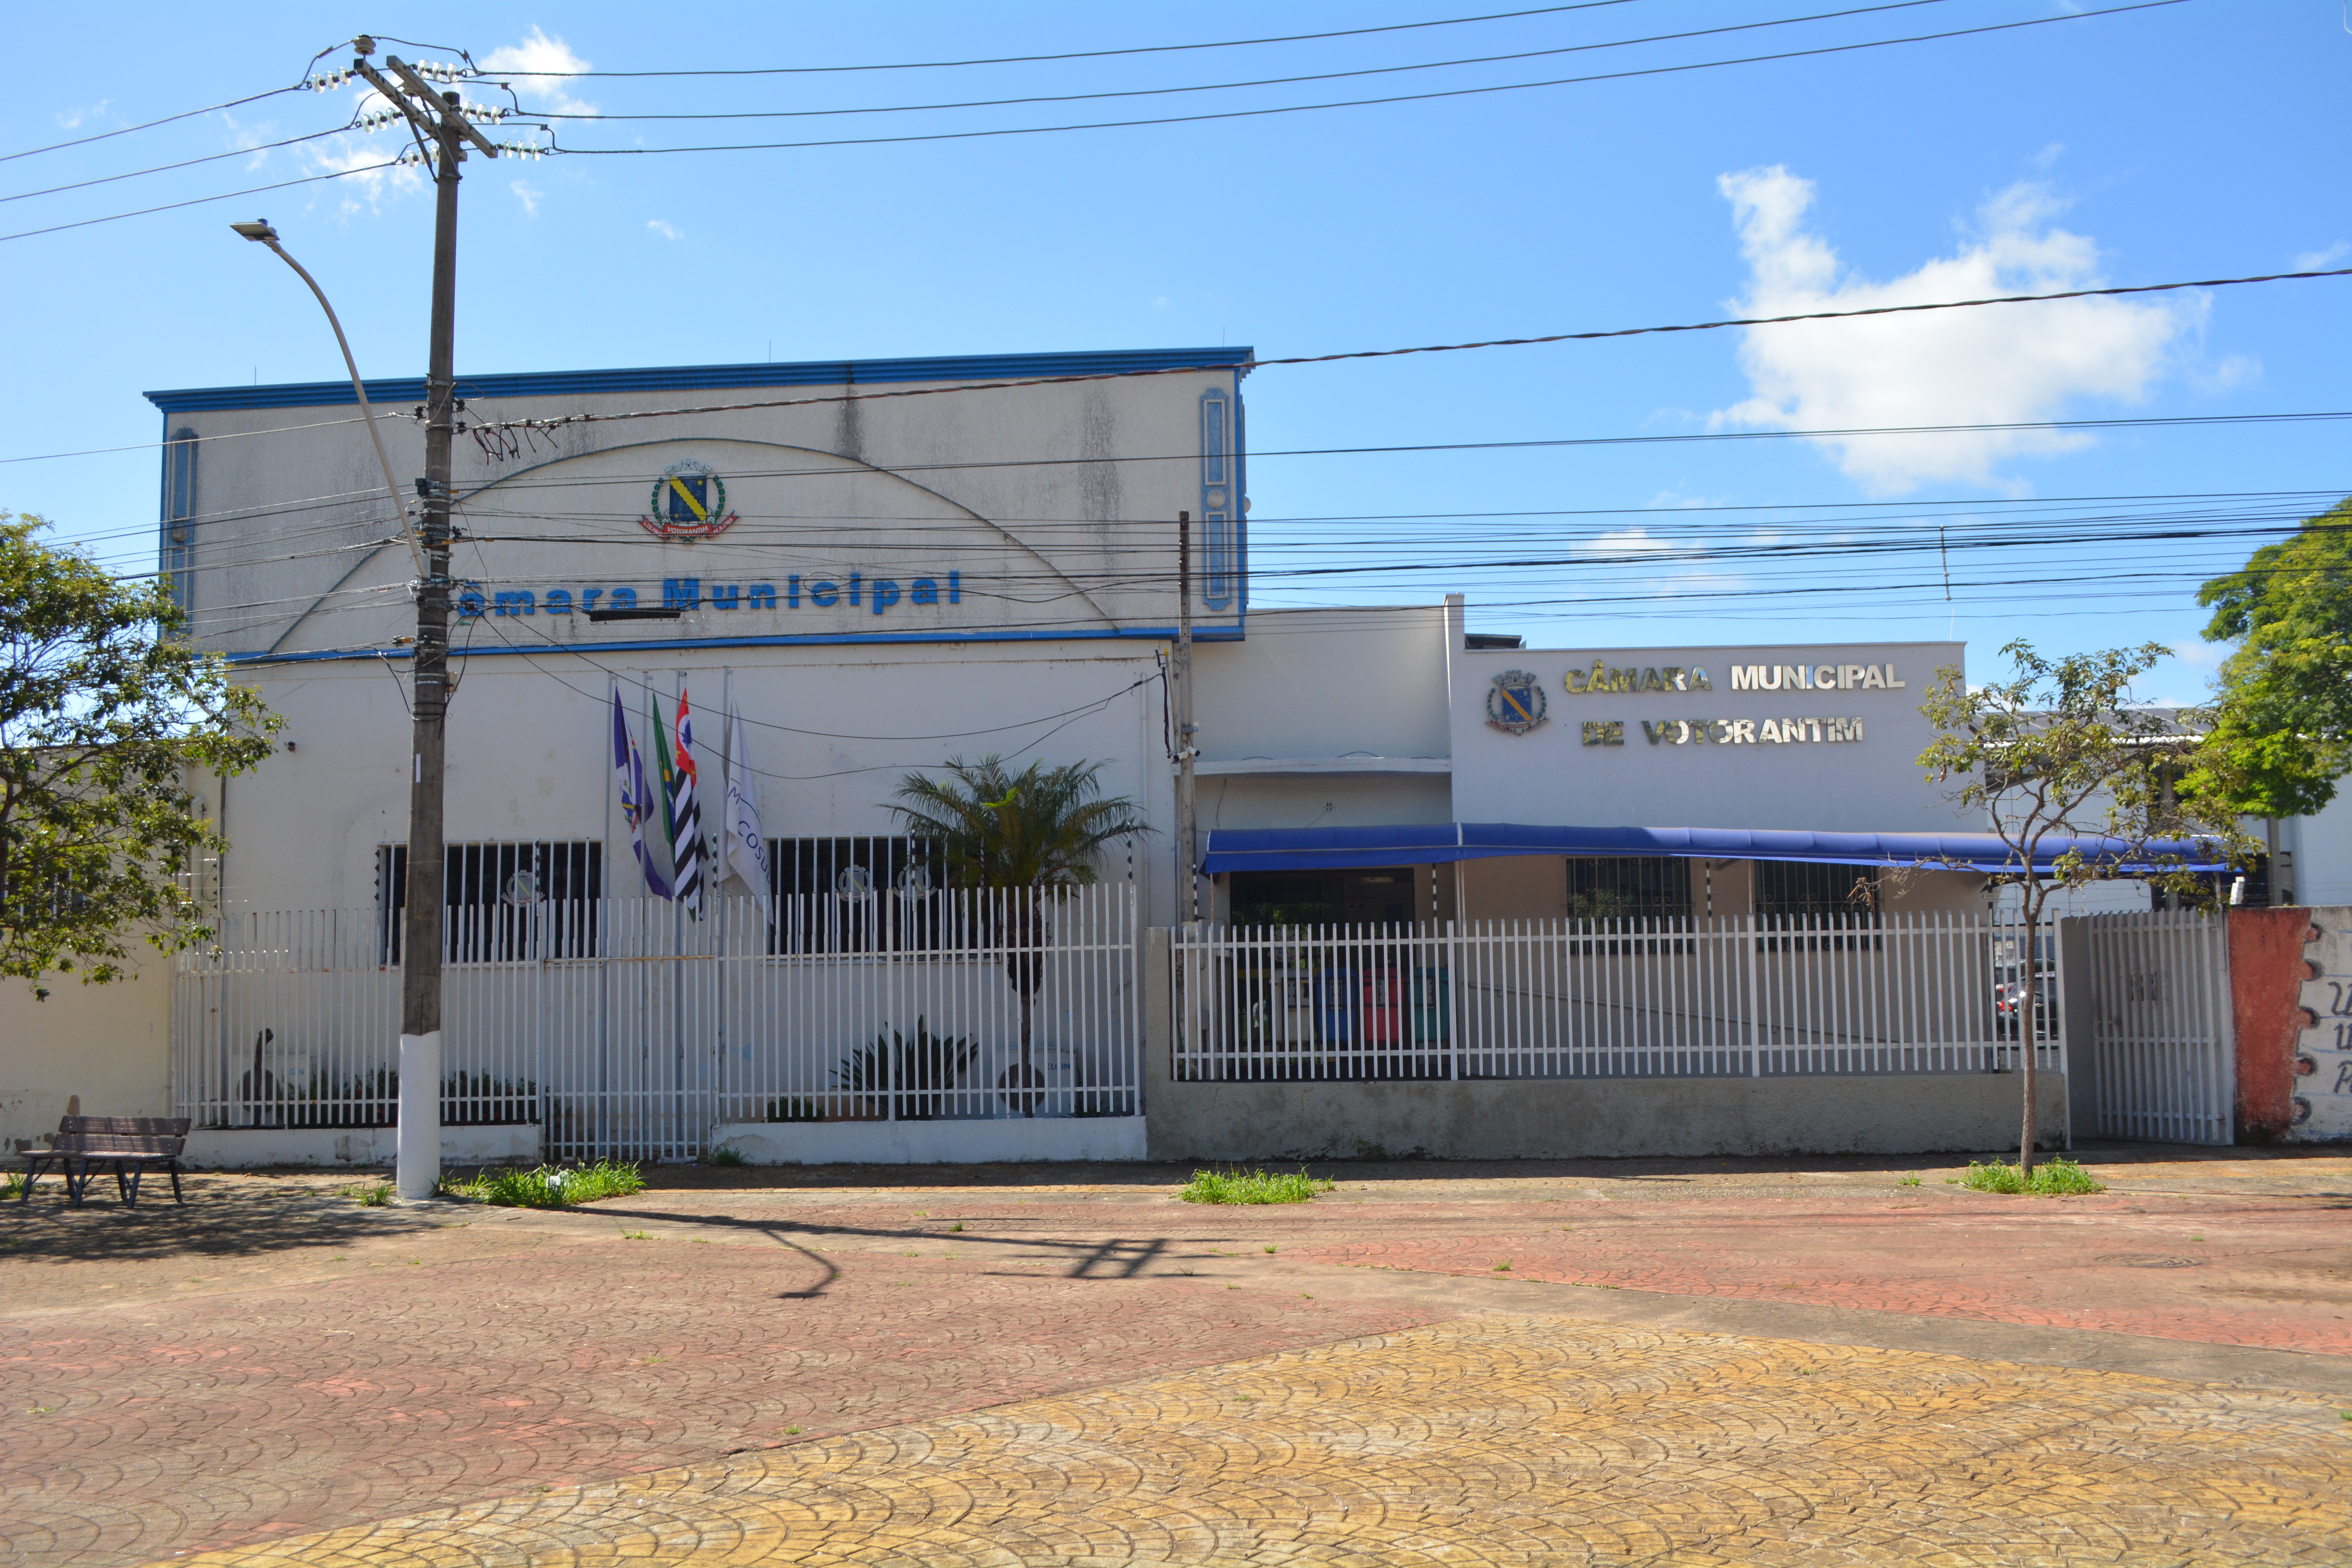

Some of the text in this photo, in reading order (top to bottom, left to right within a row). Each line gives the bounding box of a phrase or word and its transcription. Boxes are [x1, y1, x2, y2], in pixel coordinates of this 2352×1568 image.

[457, 570, 960, 617] âmara Municipal
[1564, 659, 1906, 693] CÂMARA MUNICIPAL
[1583, 717, 1862, 746] DE VOTORANTIM
[728, 787, 770, 884] MCOSUL
